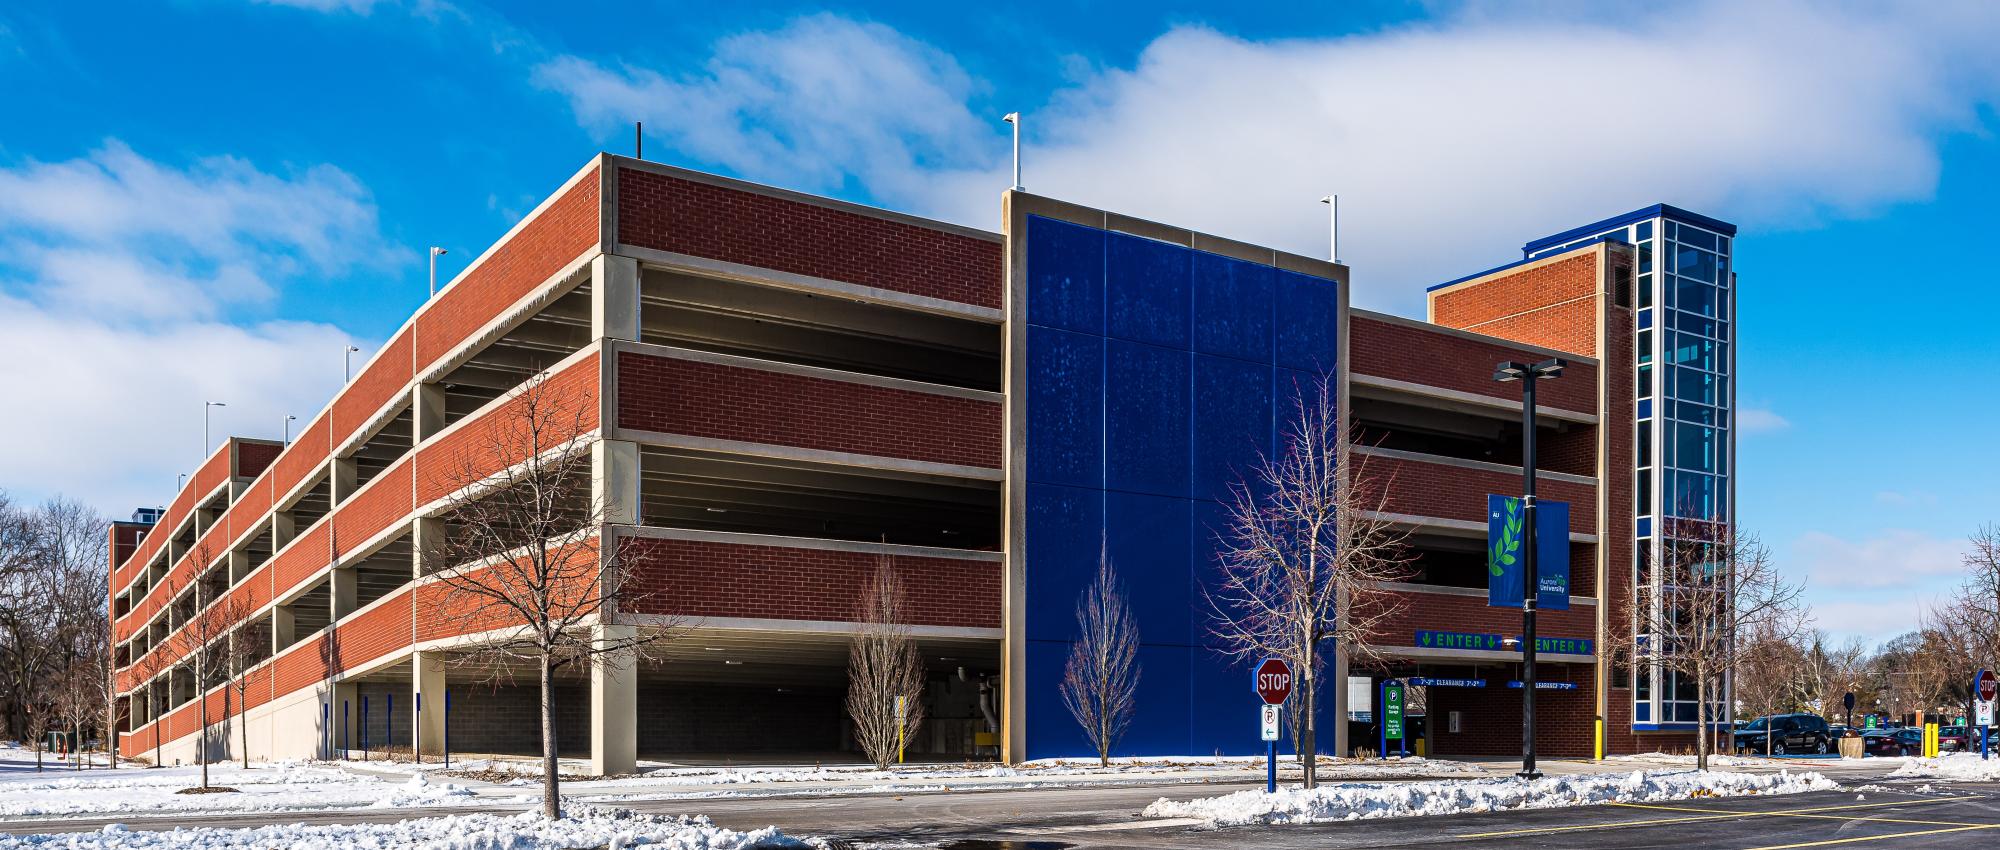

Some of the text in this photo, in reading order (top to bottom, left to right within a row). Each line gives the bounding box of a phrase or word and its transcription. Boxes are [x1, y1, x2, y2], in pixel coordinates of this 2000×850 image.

[1540, 585, 1564, 593] University
[1436, 633, 1482, 648] ENTER
[1535, 639, 1575, 652] ENTER
[1260, 673, 1290, 690] STOP
[1436, 679, 1464, 687] CLEARANCE
[1980, 680, 1995, 691] STOP
[1391, 692, 1396, 700] P
